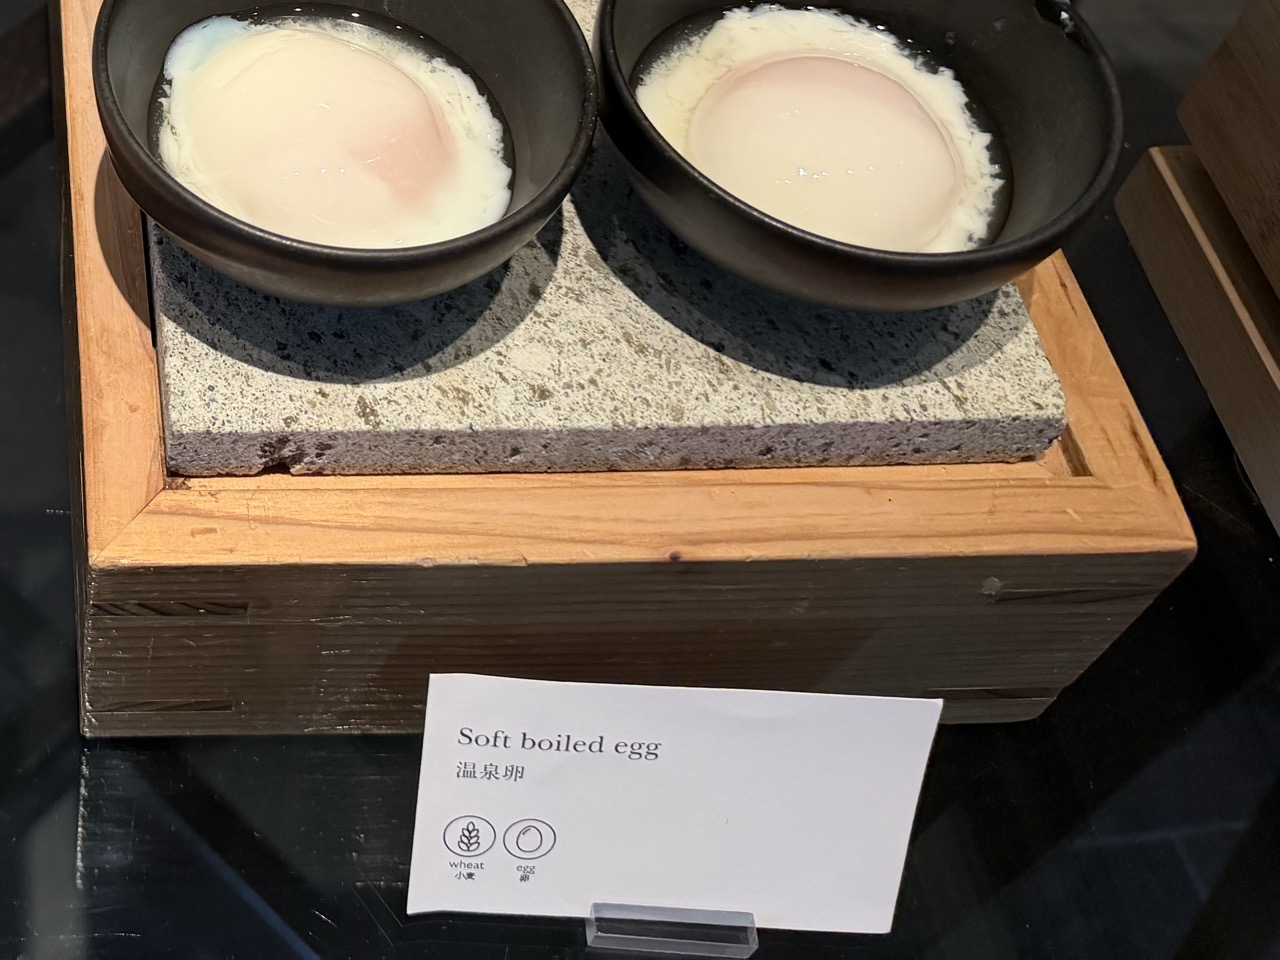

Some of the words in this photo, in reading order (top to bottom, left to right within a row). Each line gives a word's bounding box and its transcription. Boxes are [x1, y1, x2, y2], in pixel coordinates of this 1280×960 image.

[457, 726, 512, 750] Soft
[520, 731, 605, 754] boiled
[613, 739, 663, 762] egg
[455, 760, 525, 783] 温泉卵
[448, 859, 485, 872] wheat
[516, 863, 536, 875] egg
